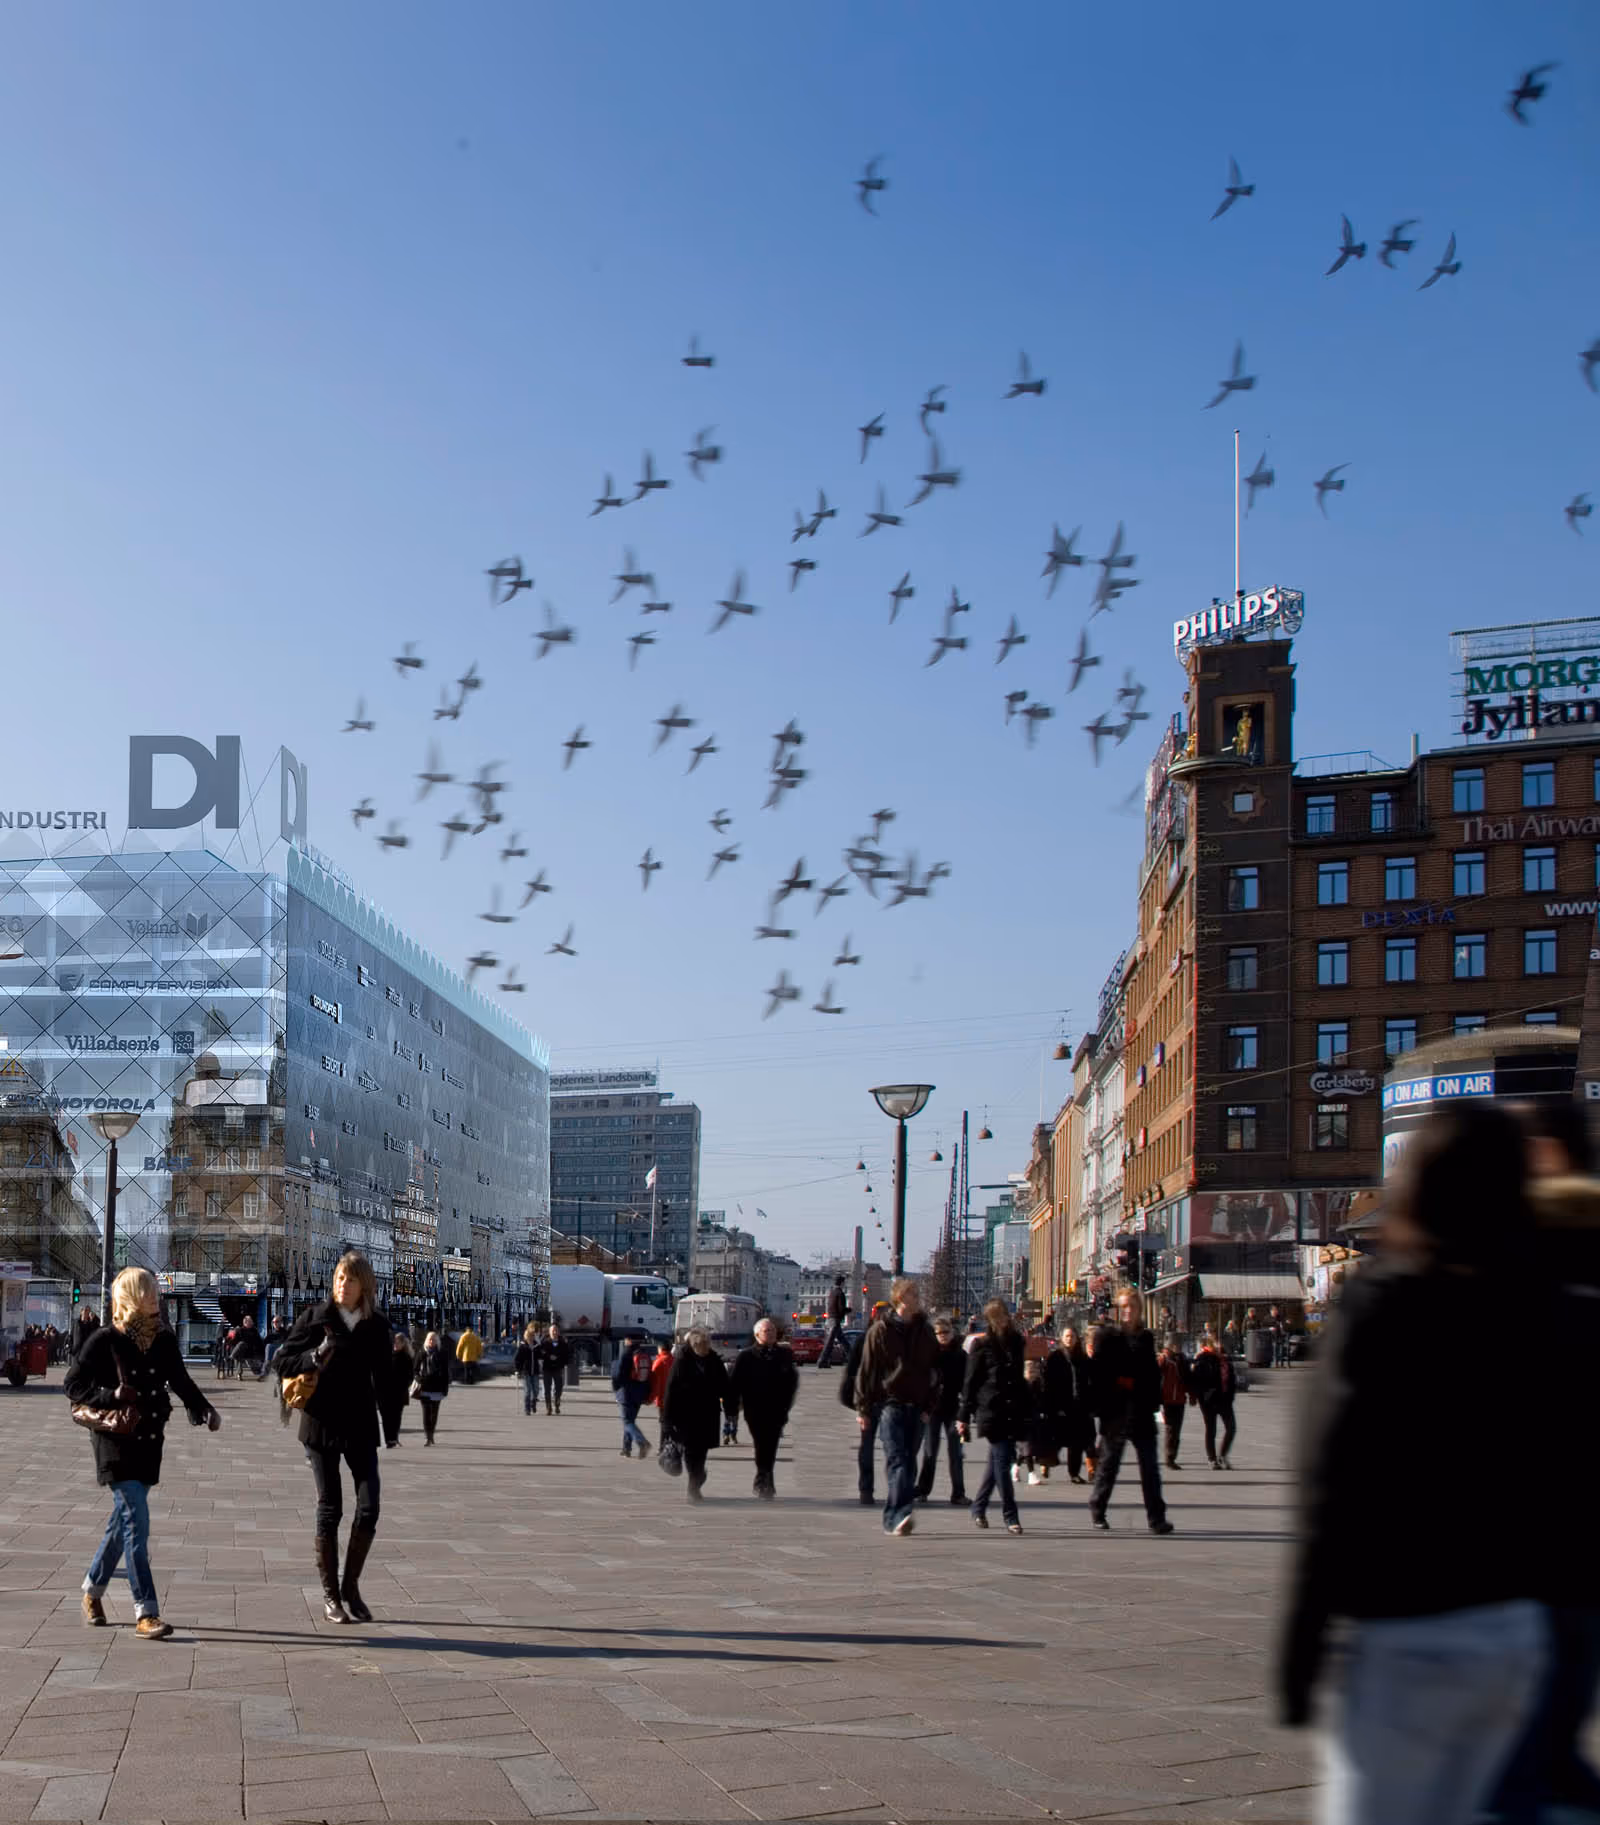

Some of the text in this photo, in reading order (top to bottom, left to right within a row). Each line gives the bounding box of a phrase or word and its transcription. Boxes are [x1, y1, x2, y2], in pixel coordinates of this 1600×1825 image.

[1173, 586, 1278, 646] PHILIPS
[128, 735, 240, 829] DI
[281, 744, 308, 848] DI
[1459, 815, 1514, 843] Thai
[88, 978, 230, 993] COMPUTERVISION
[64, 1034, 160, 1052] Villadsen's
[599, 1071, 651, 1084] Landsbank
[1310, 1071, 1376, 1093] Carlsberg
[1437, 1075, 1492, 1096] ON AIR
[1395, 1086, 1411, 1102] ON
[1412, 1082, 1431, 1099] AIR
[59, 1097, 156, 1111] MOTOROLA
[143, 1156, 193, 1171] BASF
